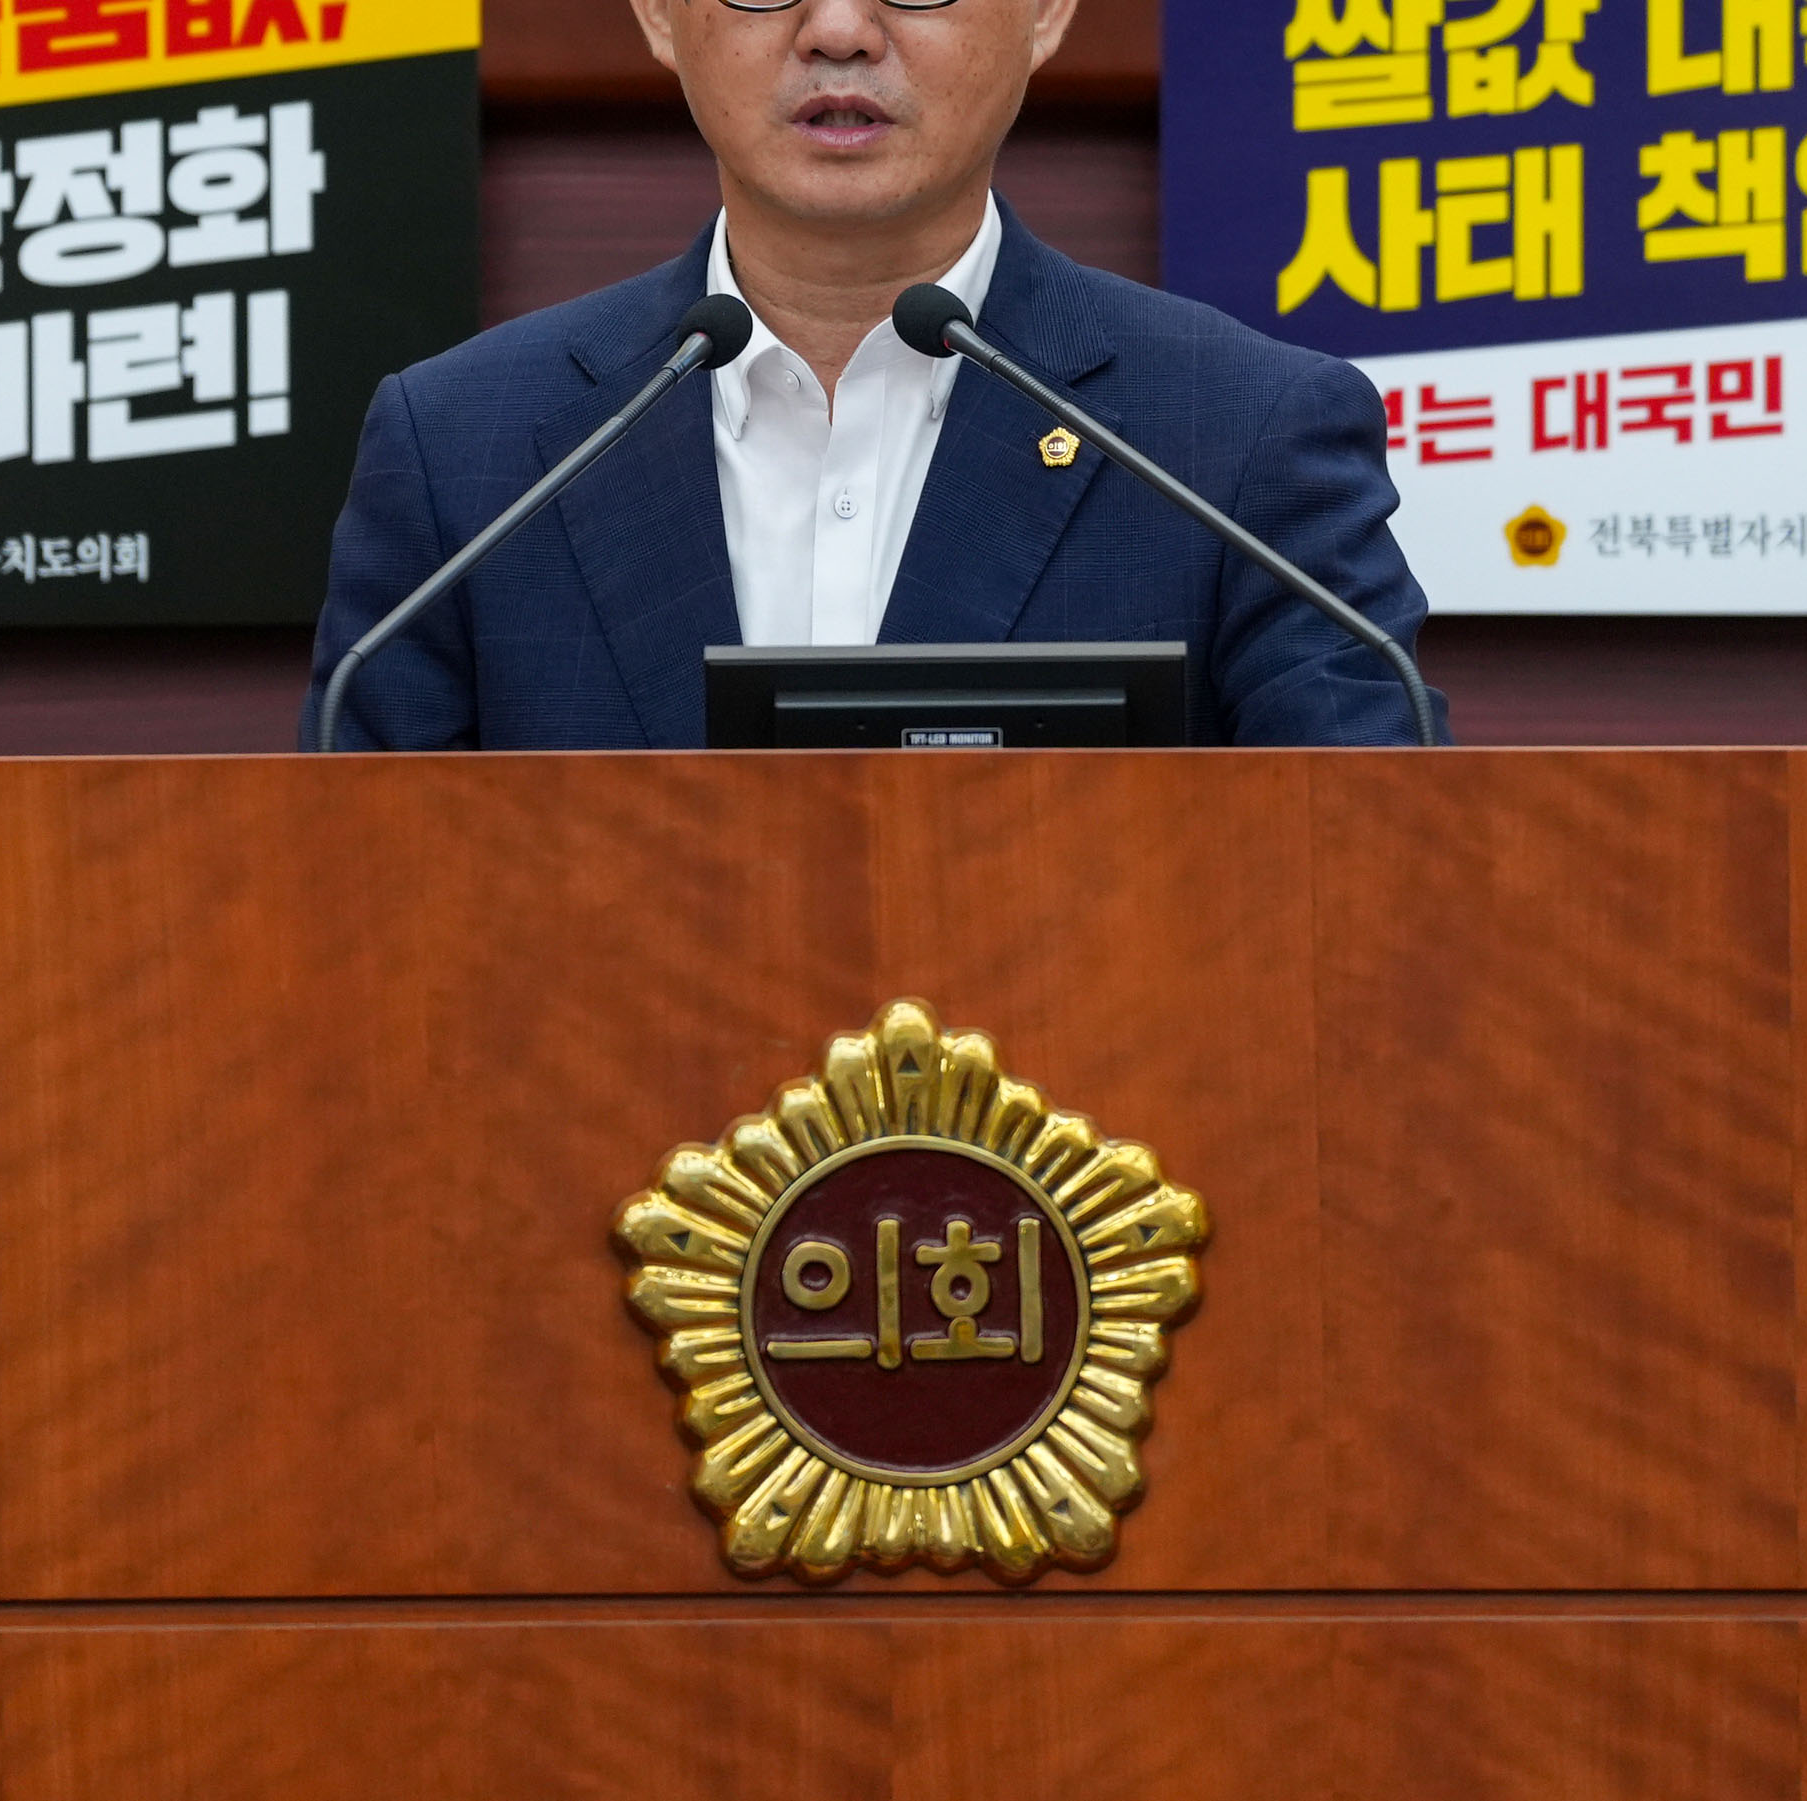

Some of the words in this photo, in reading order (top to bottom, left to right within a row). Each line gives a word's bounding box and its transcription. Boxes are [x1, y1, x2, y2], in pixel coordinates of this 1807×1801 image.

[1277, 143, 1585, 315] 사태
[1532, 356, 1783, 453] 대국민
[949, 733, 994, 744] MONITOR
[766, 1218, 1043, 1368] 의회
